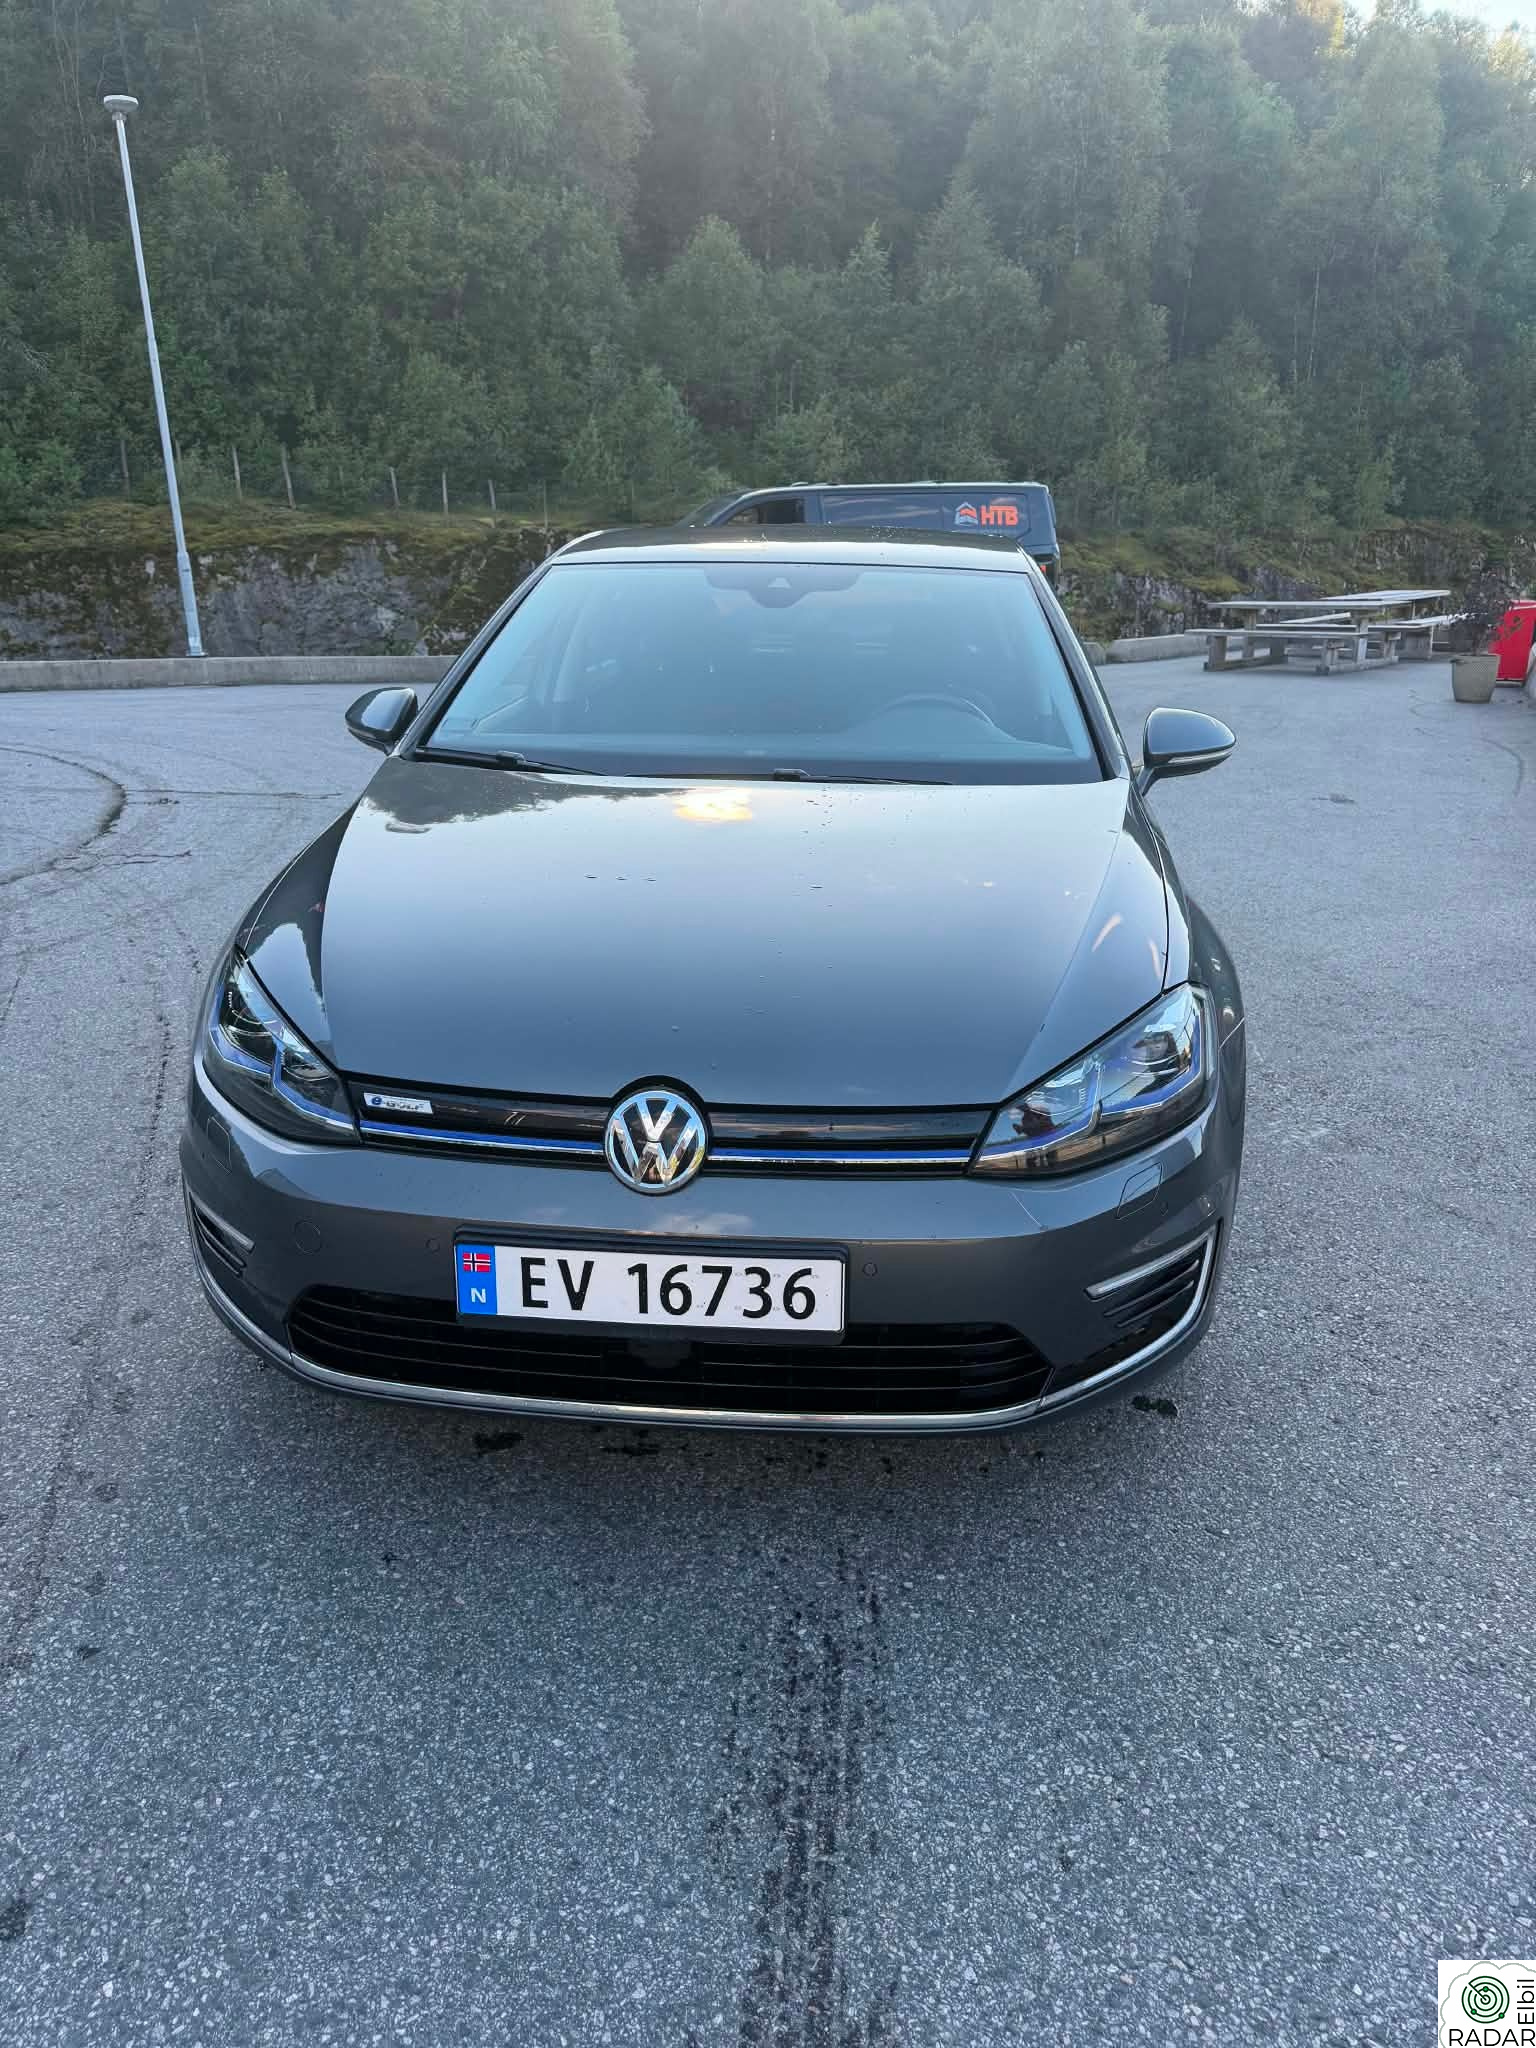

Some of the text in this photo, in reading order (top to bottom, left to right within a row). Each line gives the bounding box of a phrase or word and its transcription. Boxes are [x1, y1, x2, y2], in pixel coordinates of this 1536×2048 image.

[981, 505, 1018, 525] HTB
[608, 1094, 702, 1188] VW
[470, 1287, 486, 1303] N
[521, 1257, 816, 1320] EV 16736
